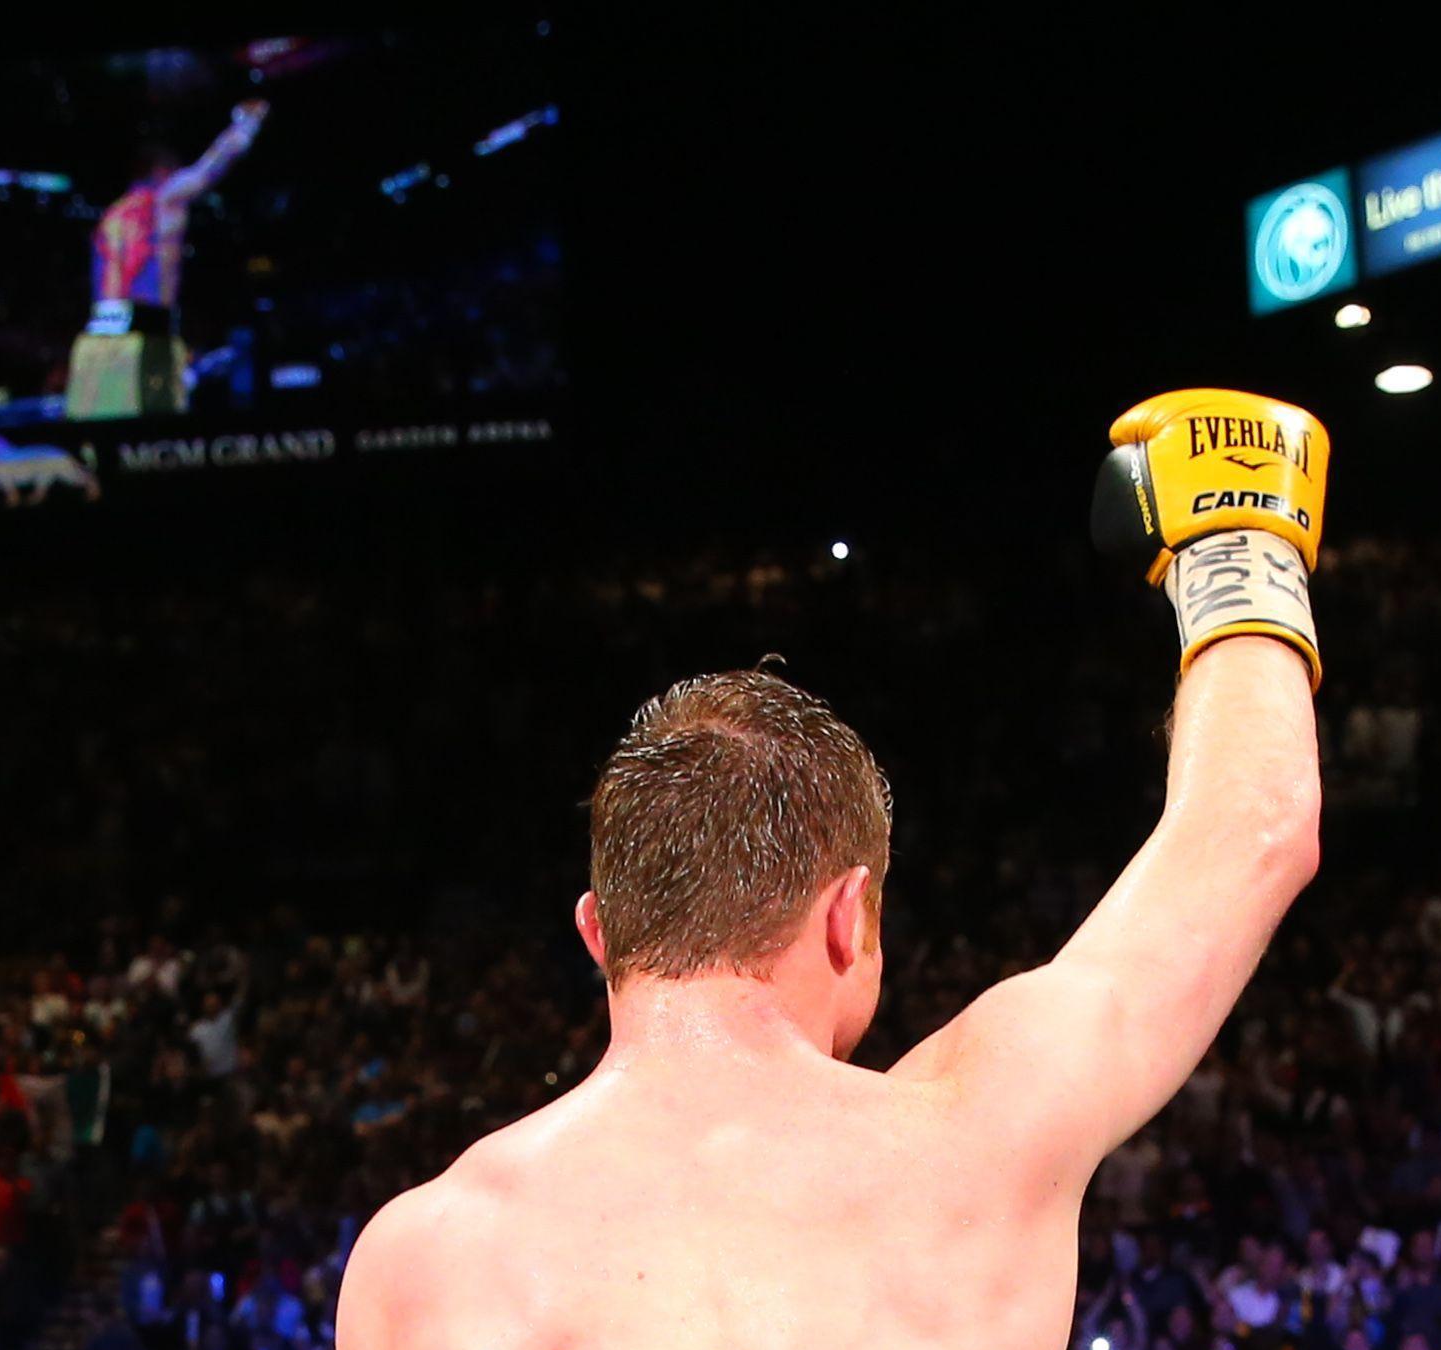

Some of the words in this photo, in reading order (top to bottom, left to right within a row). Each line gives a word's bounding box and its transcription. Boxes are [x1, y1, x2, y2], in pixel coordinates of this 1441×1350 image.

[1365, 185, 1423, 231] Live
[116, 437, 208, 471] MGM
[209, 428, 337, 468] GRAND
